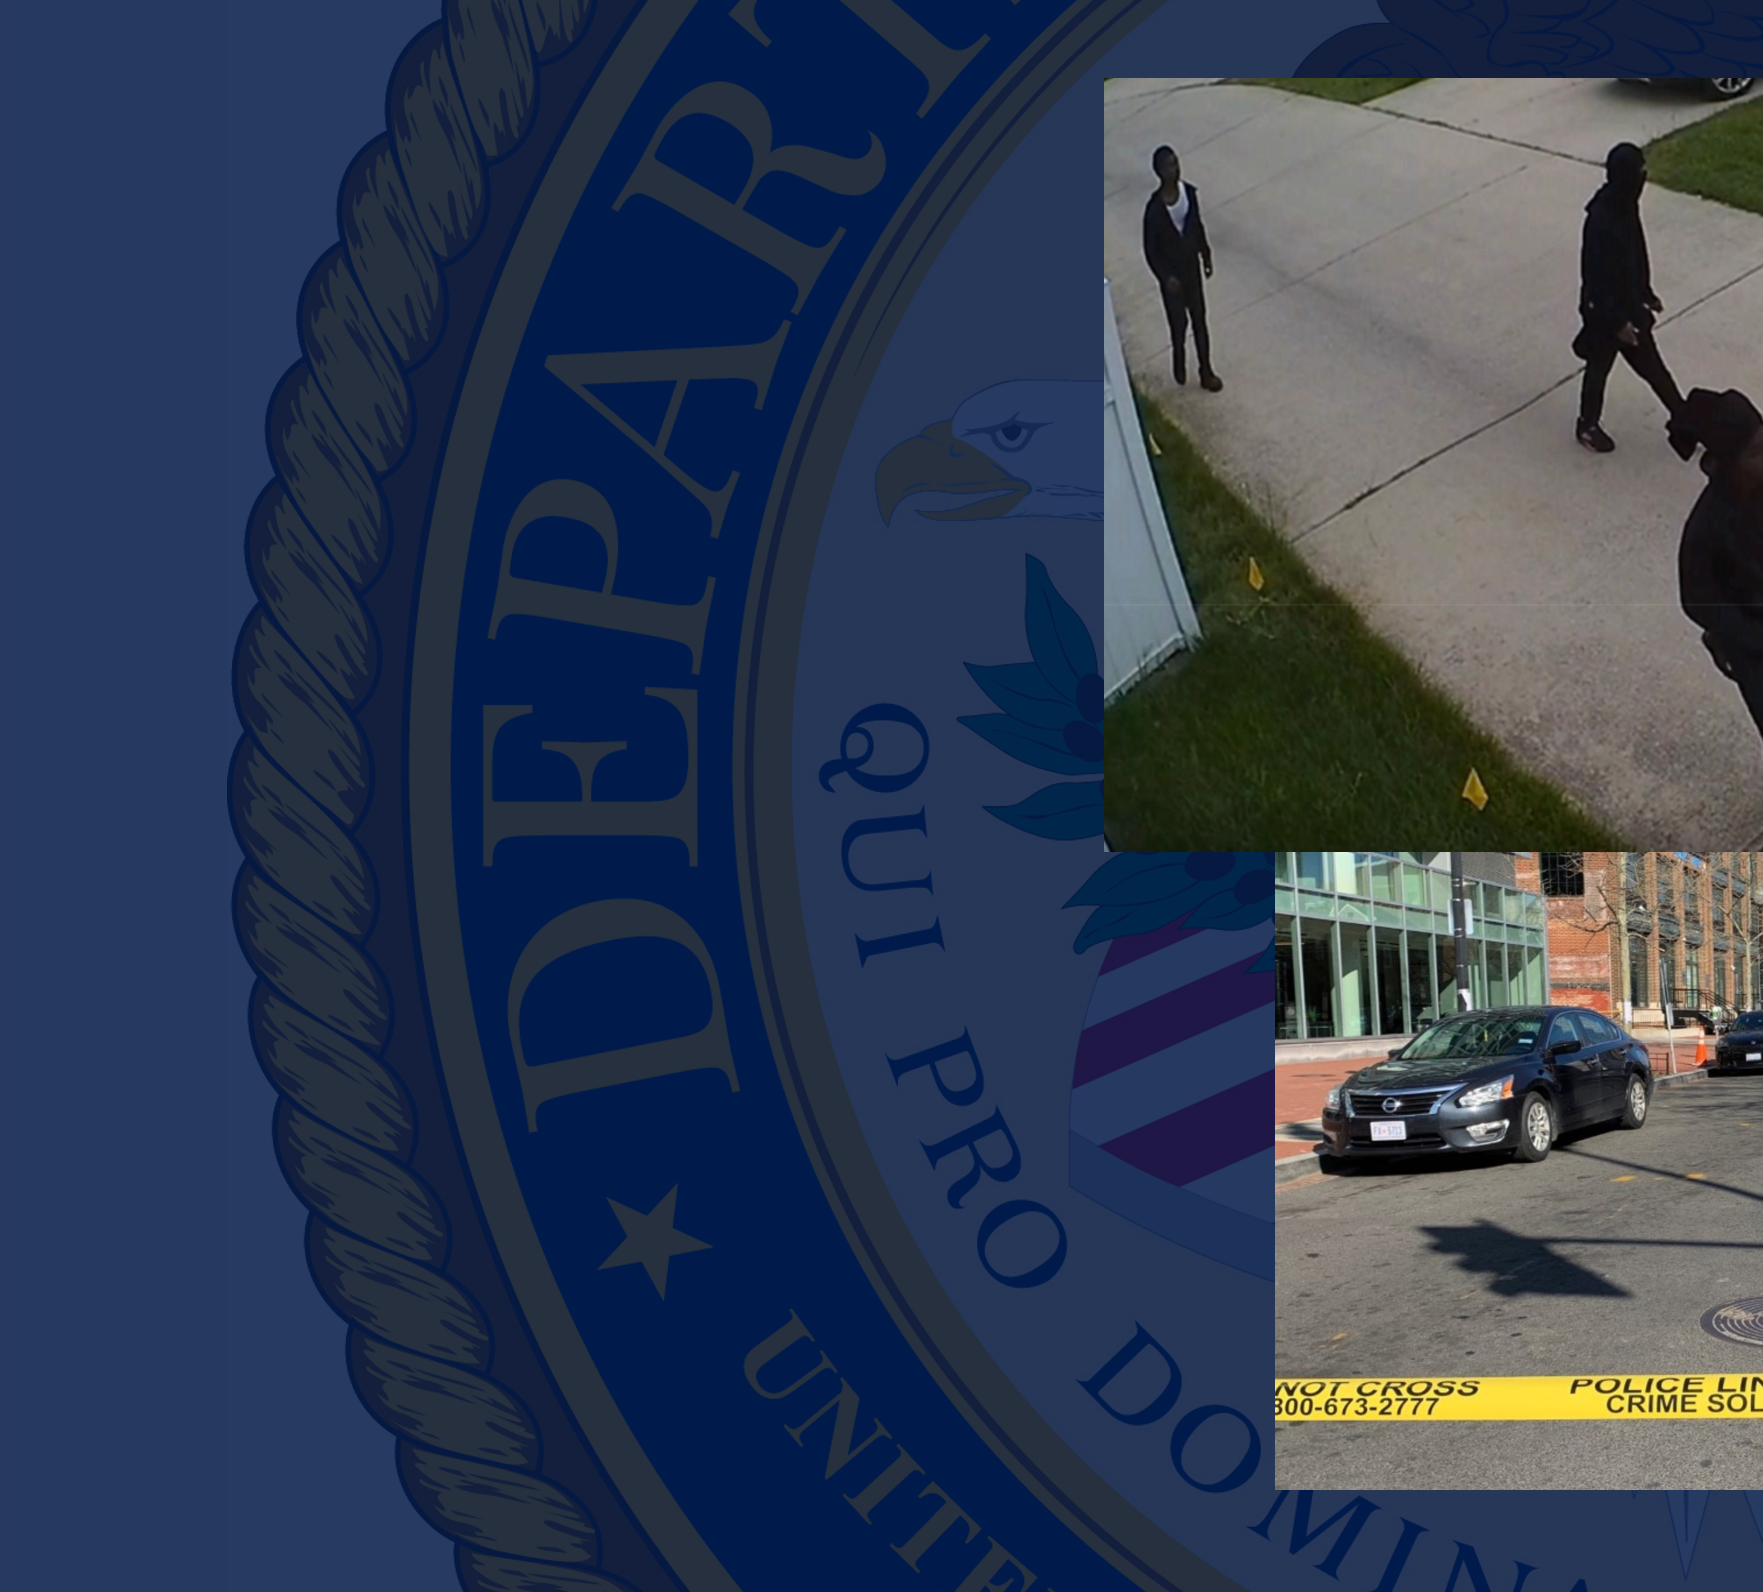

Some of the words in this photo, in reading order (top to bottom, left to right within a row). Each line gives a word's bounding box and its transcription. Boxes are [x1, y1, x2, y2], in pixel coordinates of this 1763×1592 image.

[818, 702, 946, 969] QUI
[884, 1025, 1068, 1289] PRO
[1275, 1381, 1350, 1397] NOT
[1356, 1380, 1481, 1397] CROSS
[1569, 1377, 1704, 1395] POLICE
[1606, 1395, 1698, 1414] CRIME
